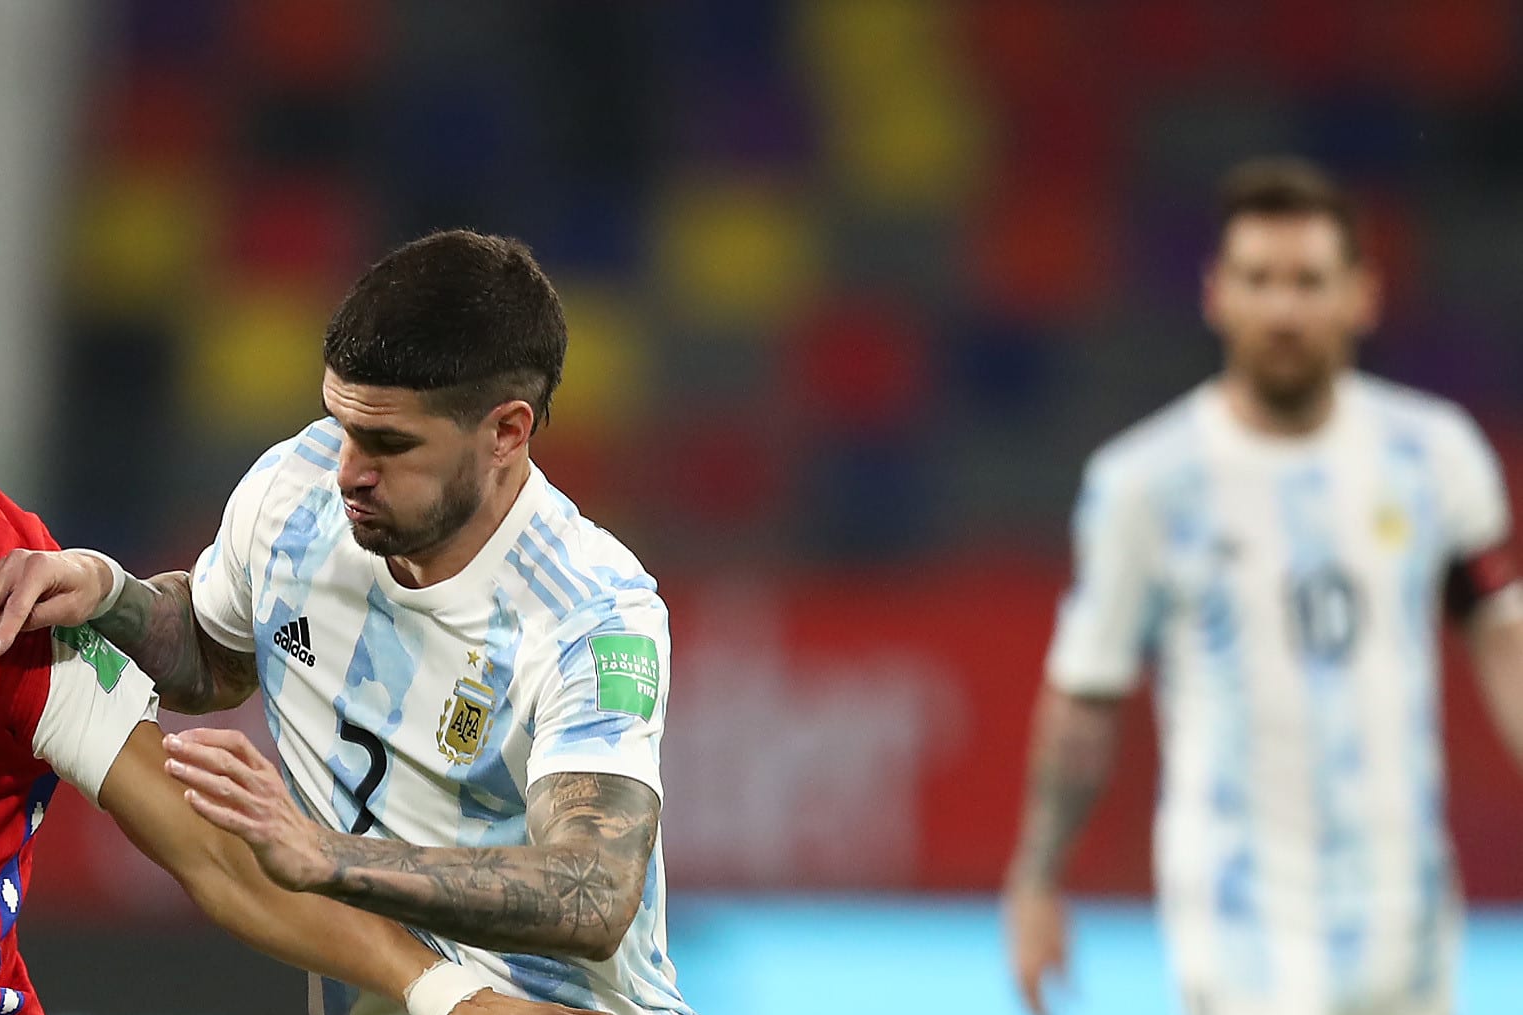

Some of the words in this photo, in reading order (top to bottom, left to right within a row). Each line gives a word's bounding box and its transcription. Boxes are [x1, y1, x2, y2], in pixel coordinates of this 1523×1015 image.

[273, 631, 316, 668] adidas
[600, 651, 657, 670] LIVING
[601, 661, 657, 680] FOOTBALL
[637, 681, 656, 700] FIFA
[450, 700, 482, 743] AFA
